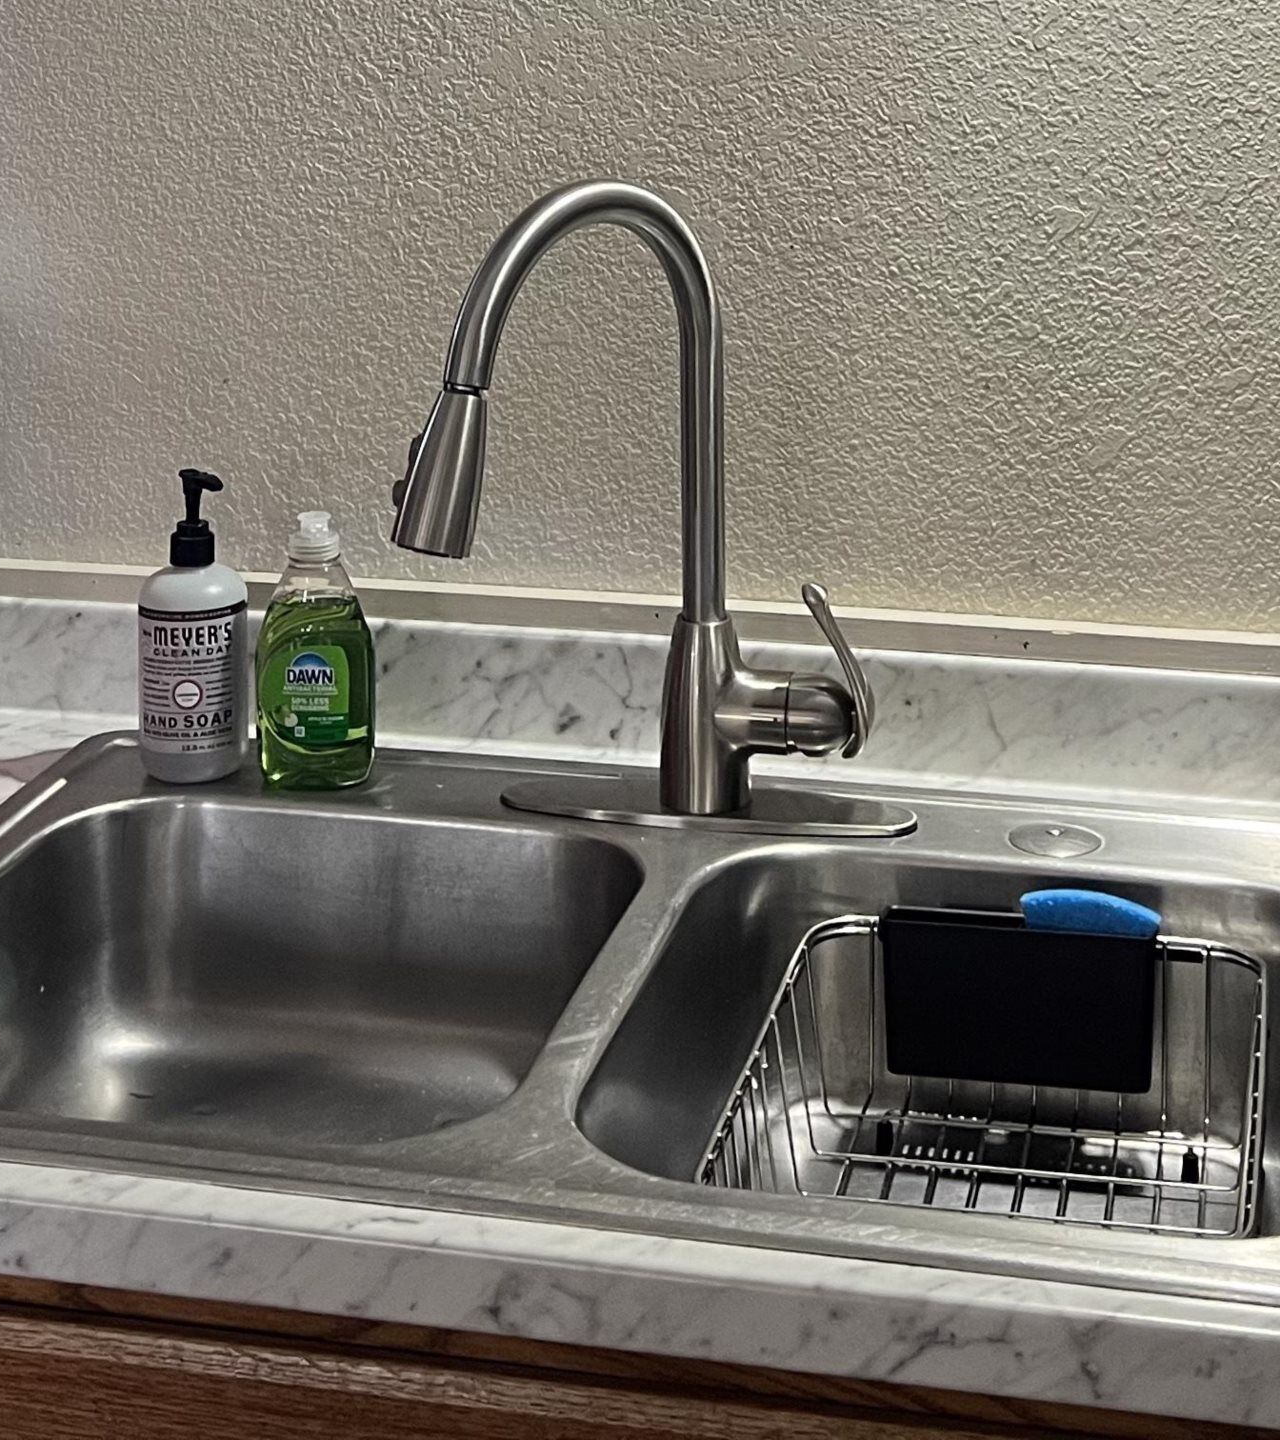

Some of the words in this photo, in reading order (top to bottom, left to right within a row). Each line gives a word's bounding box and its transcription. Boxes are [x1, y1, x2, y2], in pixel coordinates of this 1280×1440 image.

[153, 621, 232, 647] MEYER'S
[153, 647, 200, 658] CLEAN
[206, 643, 232, 656] DAY
[286, 668, 334, 685] DAWN
[144, 712, 178, 729] HAND
[183, 709, 233, 729] SOAP
